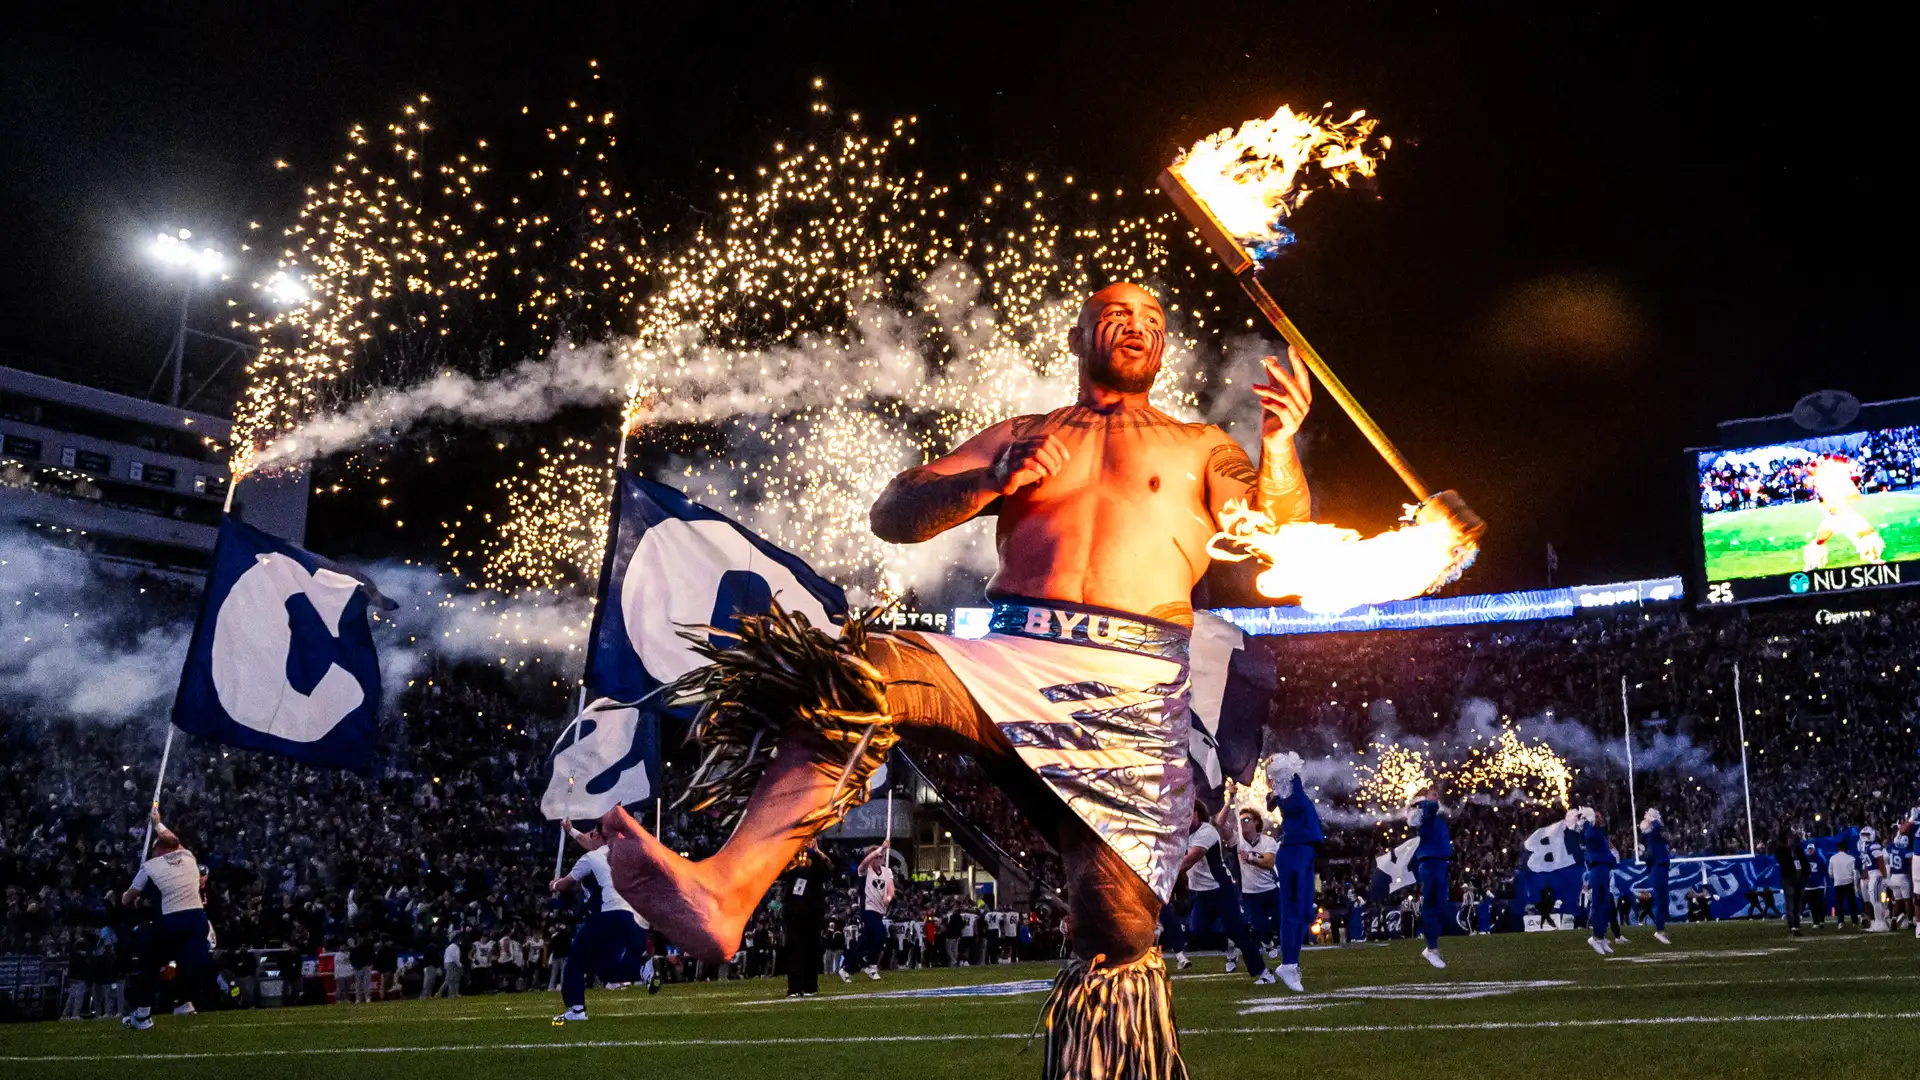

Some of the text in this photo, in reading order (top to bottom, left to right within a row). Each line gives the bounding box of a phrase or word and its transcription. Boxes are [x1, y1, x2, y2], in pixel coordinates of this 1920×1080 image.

[1814, 564, 1901, 592] NU SKIN
[1025, 606, 1119, 646] BYU
[211, 551, 366, 743] C
[1889, 853, 1903, 870] 19
